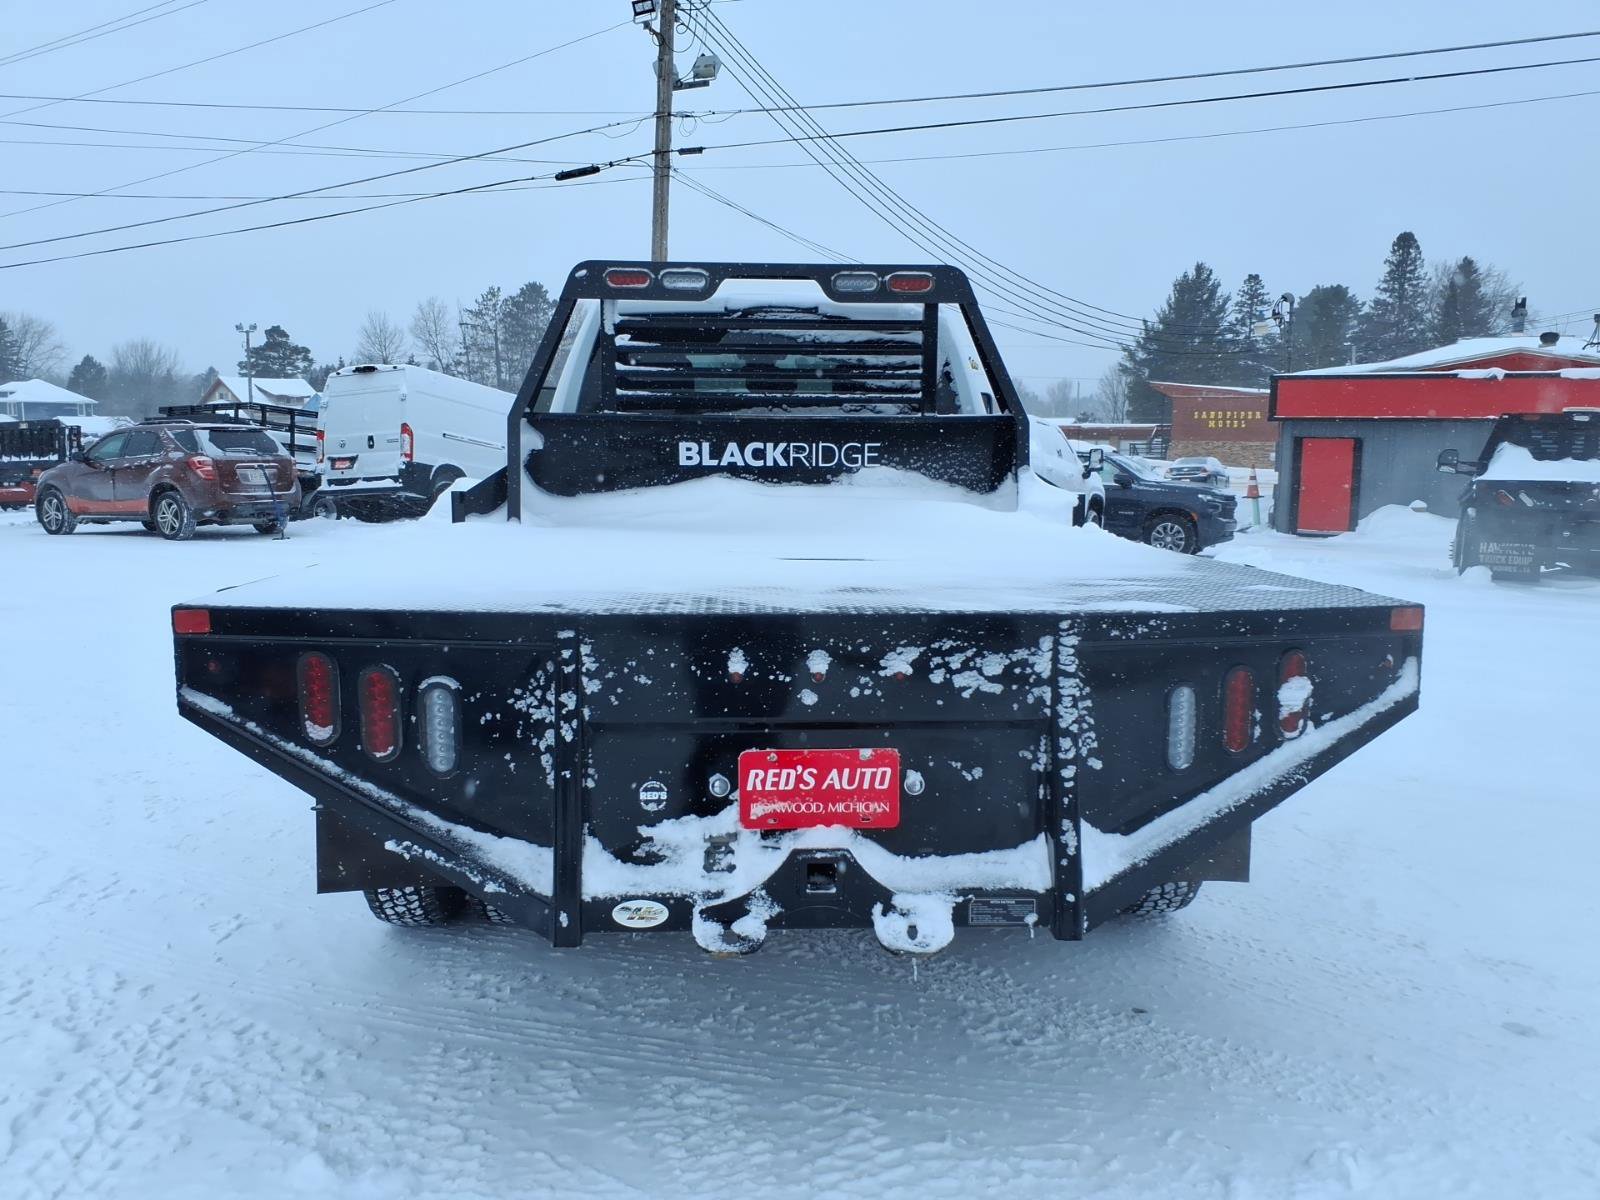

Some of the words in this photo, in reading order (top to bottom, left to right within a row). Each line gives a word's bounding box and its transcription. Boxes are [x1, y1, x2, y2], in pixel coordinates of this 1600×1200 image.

[1193, 411, 1261, 419] SANDPIPER
[1208, 420, 1246, 428] MOTEL
[678, 441, 881, 467] BLACKRIDGE
[746, 765, 817, 791] RED'S
[821, 767, 892, 790] AUTO
[827, 802, 890, 813] MICHIGAN
